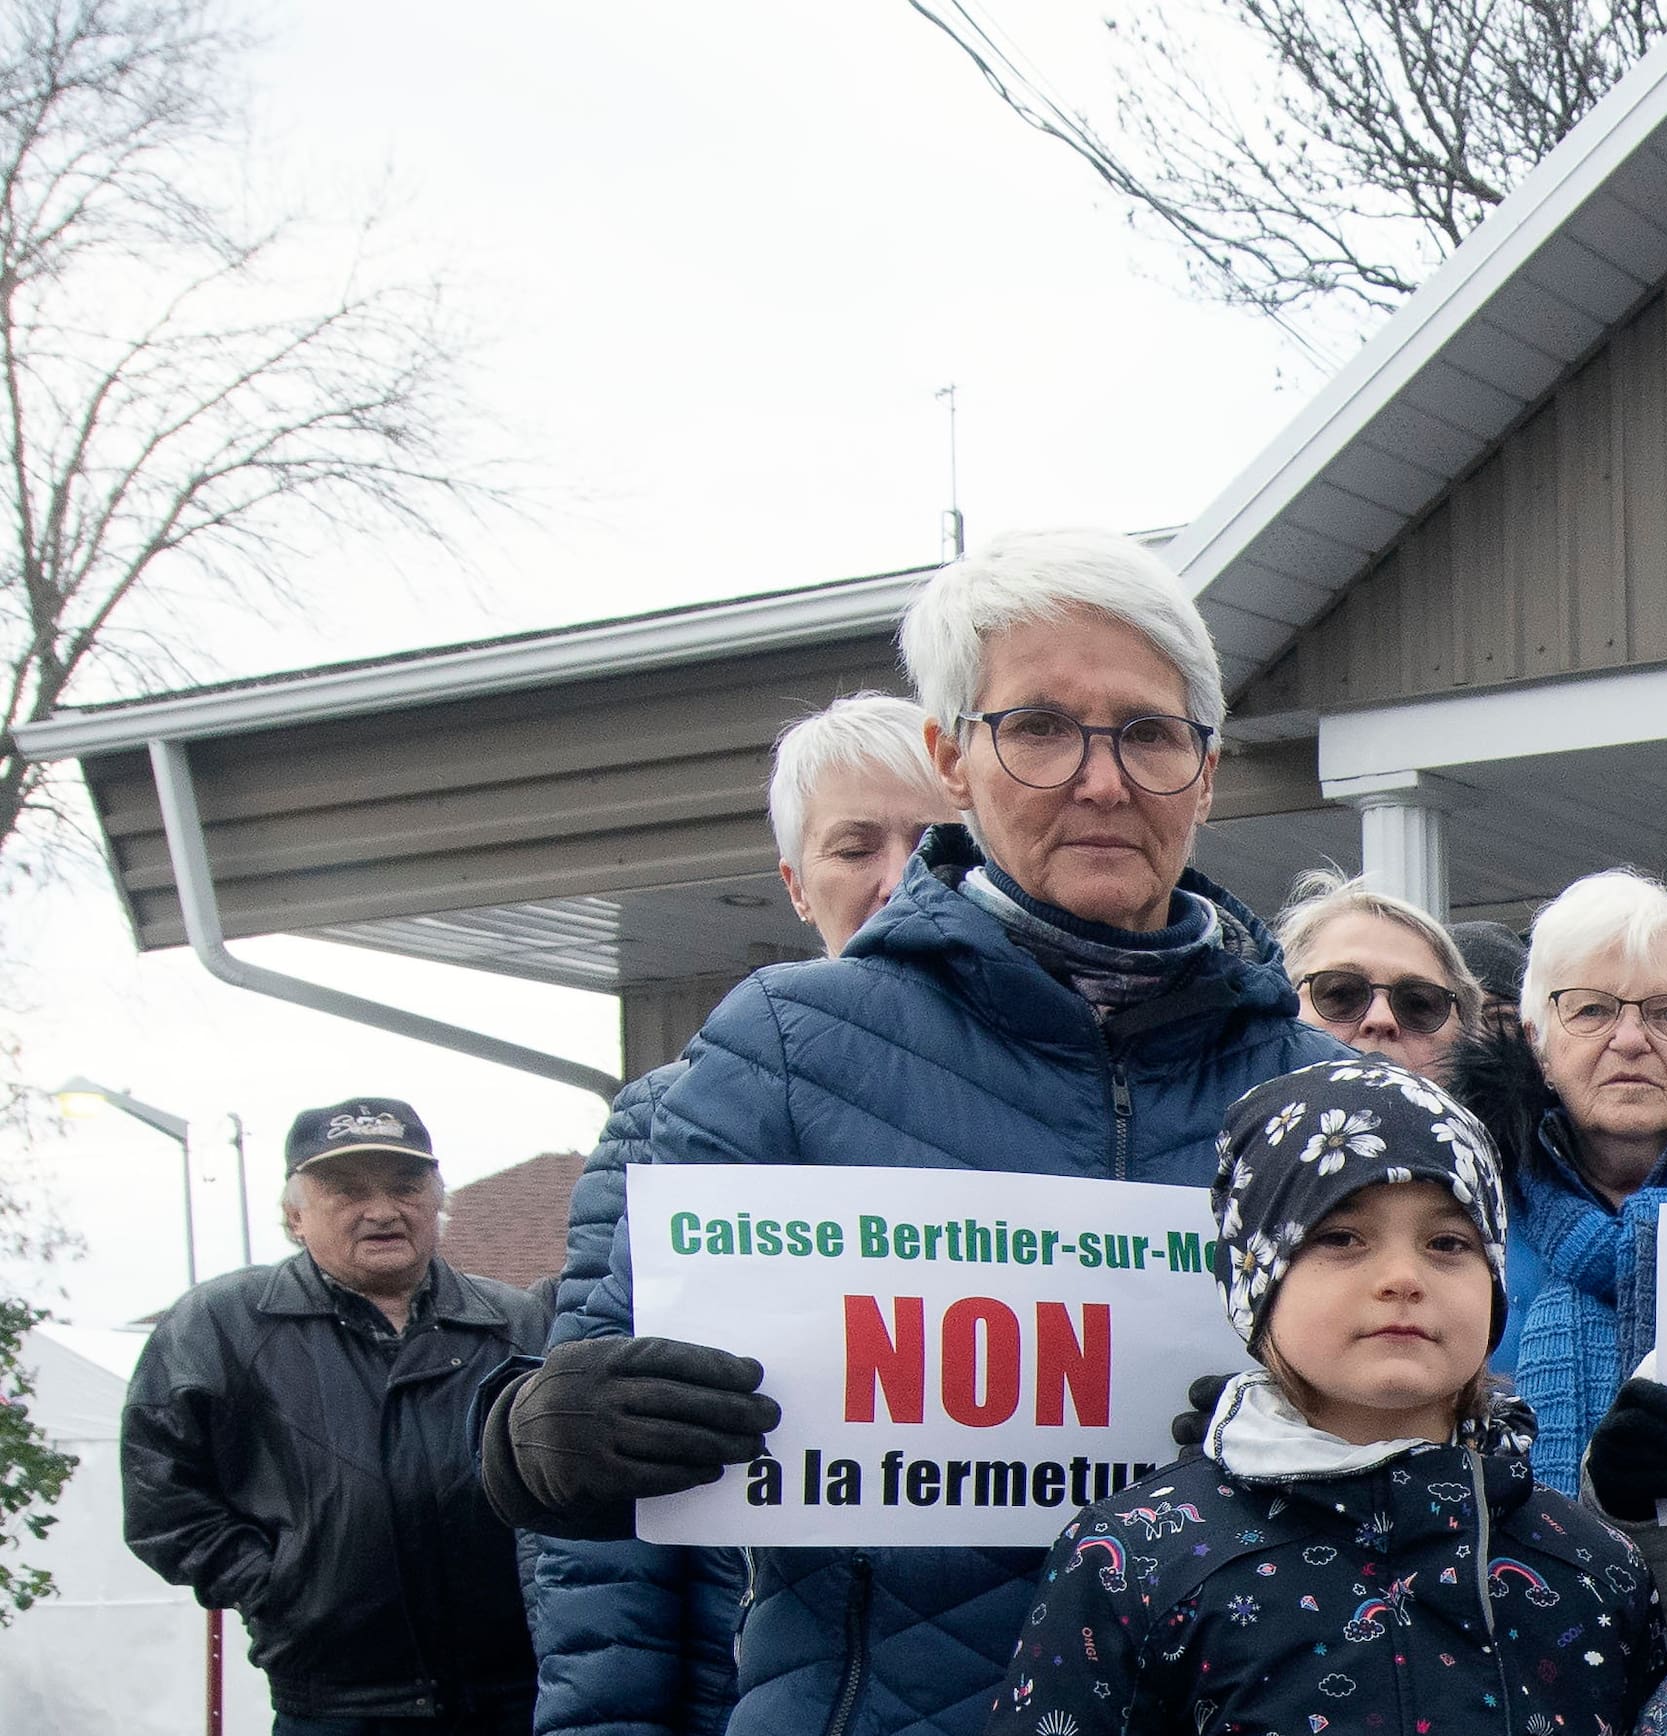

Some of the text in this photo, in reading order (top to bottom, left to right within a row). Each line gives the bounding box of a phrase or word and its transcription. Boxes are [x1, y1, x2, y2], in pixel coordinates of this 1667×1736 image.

[670, 1211, 1218, 1274] Caisse Berthier-sur-M
[844, 1295, 1110, 1427] NON
[803, 1449, 861, 1506] la
